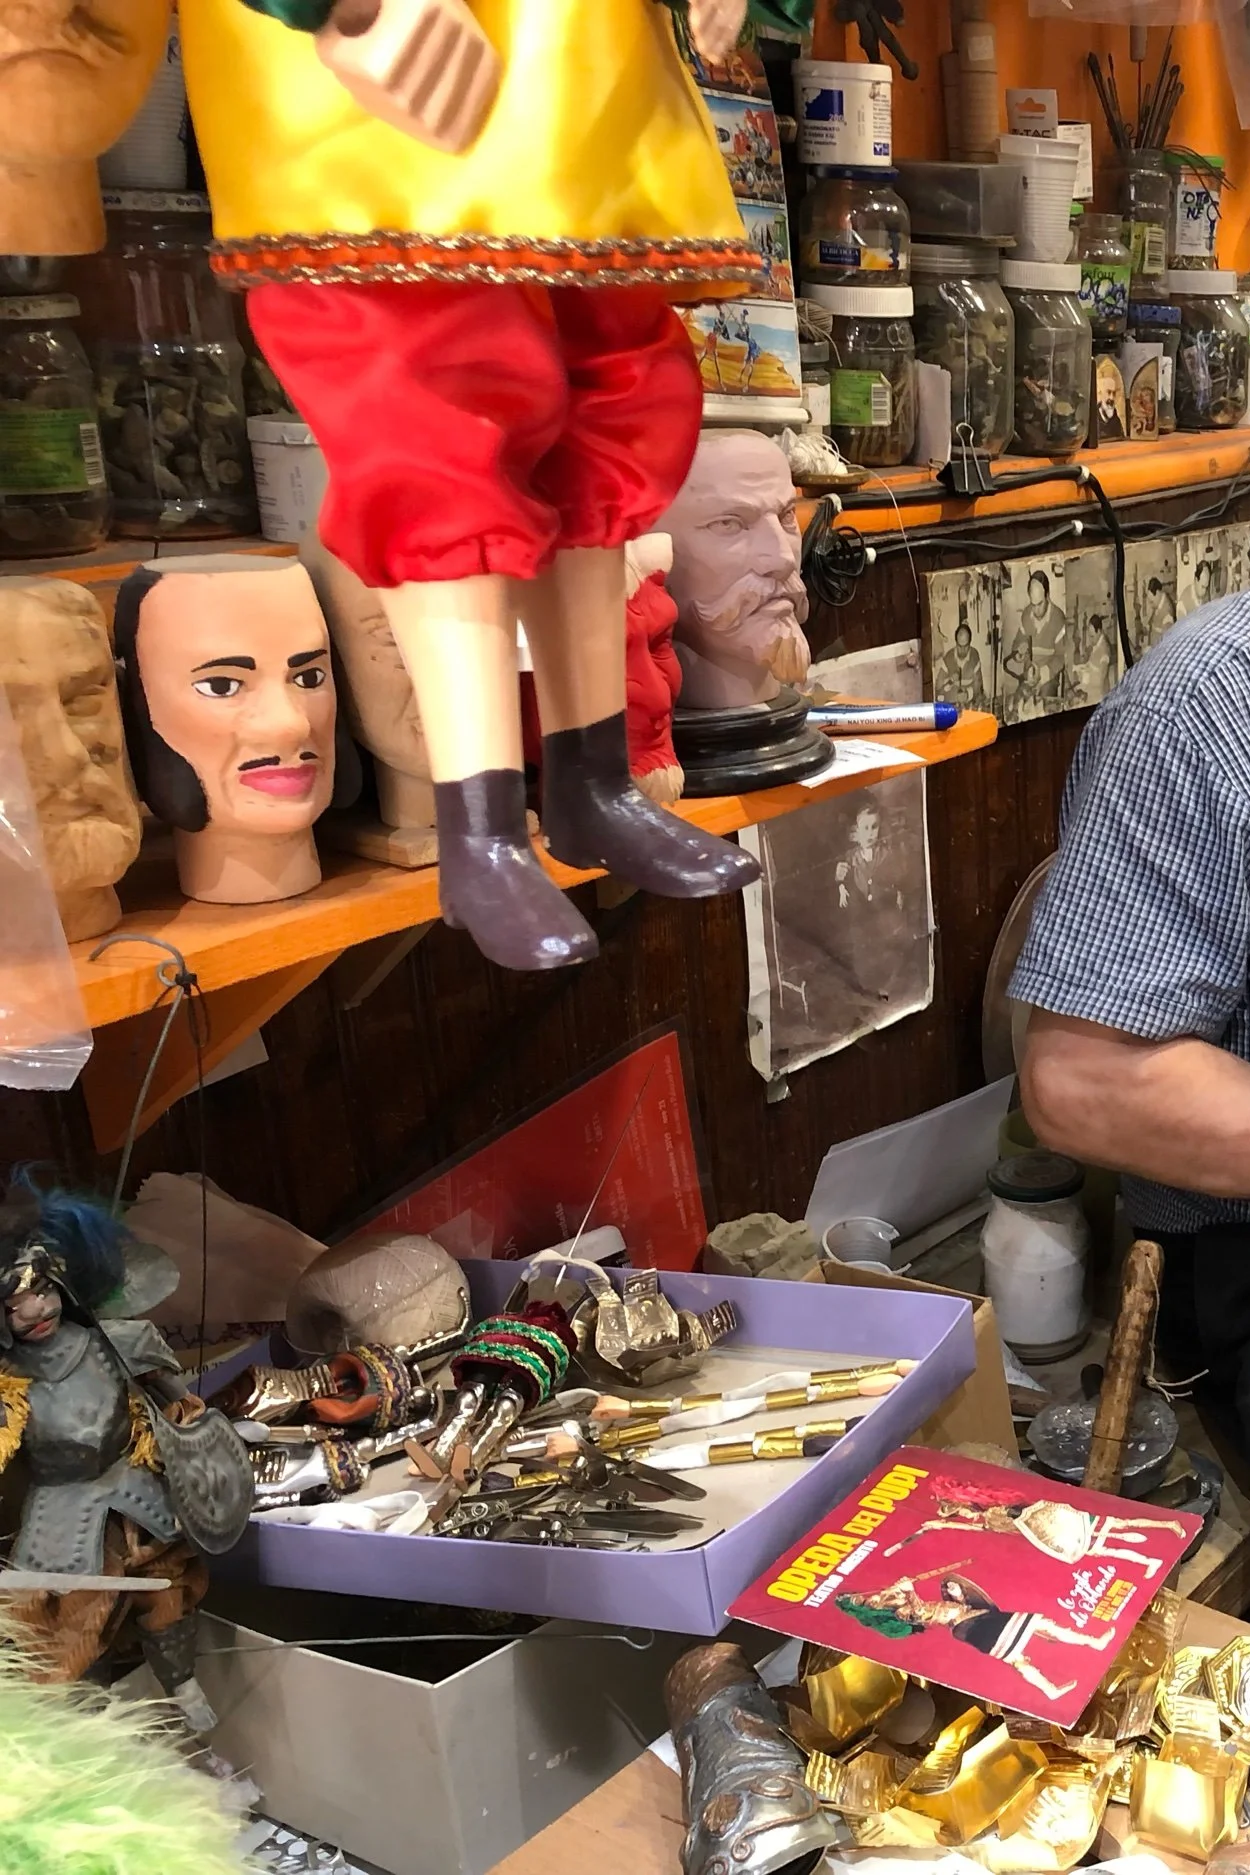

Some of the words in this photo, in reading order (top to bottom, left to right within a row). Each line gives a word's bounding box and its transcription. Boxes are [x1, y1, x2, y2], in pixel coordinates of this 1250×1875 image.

[858, 1464, 930, 1513] PUPI
[842, 1510, 887, 1536] DEI
[766, 1532, 863, 1603] OPERA
[803, 1573, 844, 1608] TEATRO
